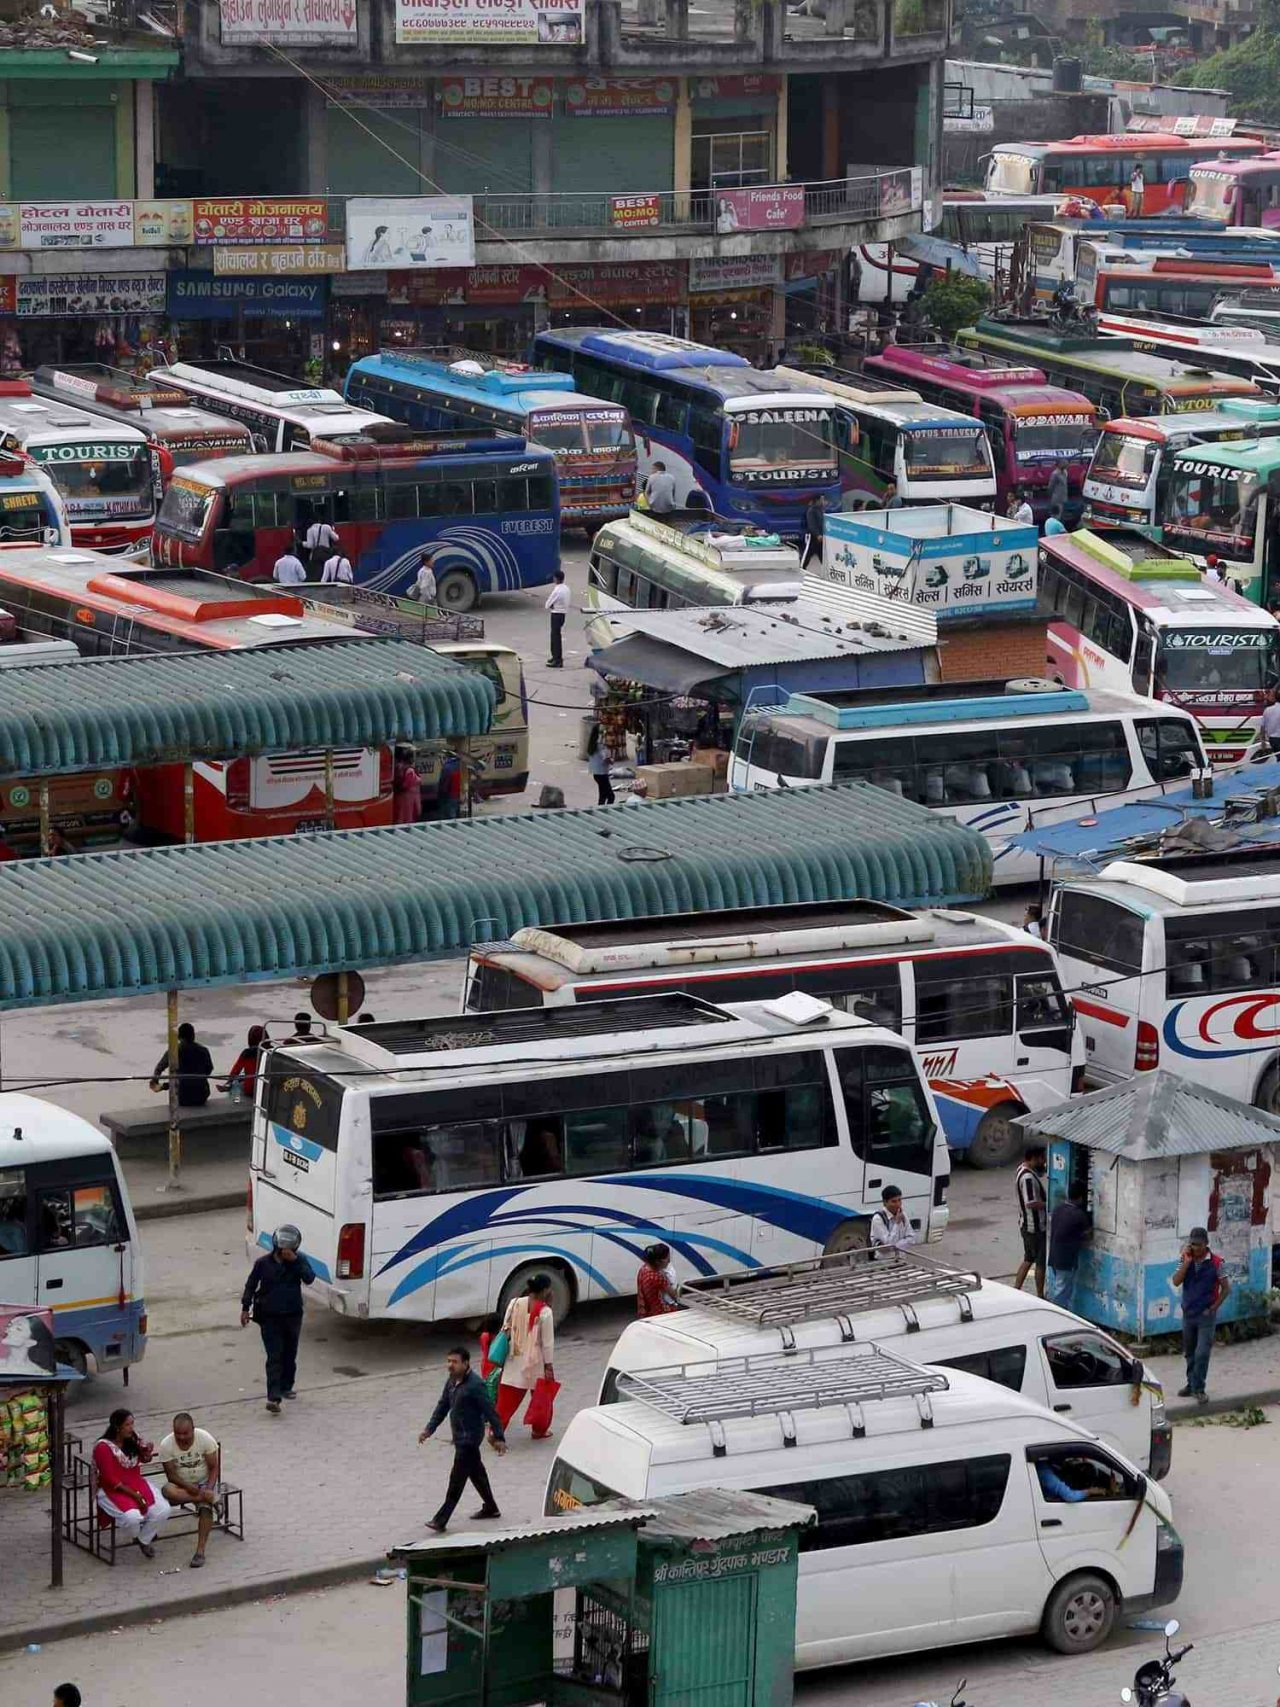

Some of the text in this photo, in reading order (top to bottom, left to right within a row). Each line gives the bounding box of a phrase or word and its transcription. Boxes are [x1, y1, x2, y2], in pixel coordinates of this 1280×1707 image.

[464, 78, 533, 97] BEST
[1189, 169, 1238, 182] TOURIST
[751, 187, 803, 202] Friends Food
[197, 202, 324, 217] चौतारी भोजनालय
[615, 198, 655, 208] BEST
[21, 205, 131, 219] होटल चौतारी
[21, 221, 71, 233] भोजनालय
[176, 282, 318, 301] SAMSUNG Galaxy
[747, 409, 830, 425] SALEENA
[42, 445, 141, 461] TOURIST
[745, 469, 829, 481] TOURIST
[1173, 459, 1257, 484] TOURIST
[4, 493, 39, 509] SHREYA
[501, 518, 554, 534] EVEREST
[829, 566, 847, 583] सेल्स
[915, 586, 940, 604] सेल्स
[953, 579, 984, 600] सर्भिस
[1184, 634, 1259, 647] TOURIST
[751, 1547, 791, 1567] भण्डार
